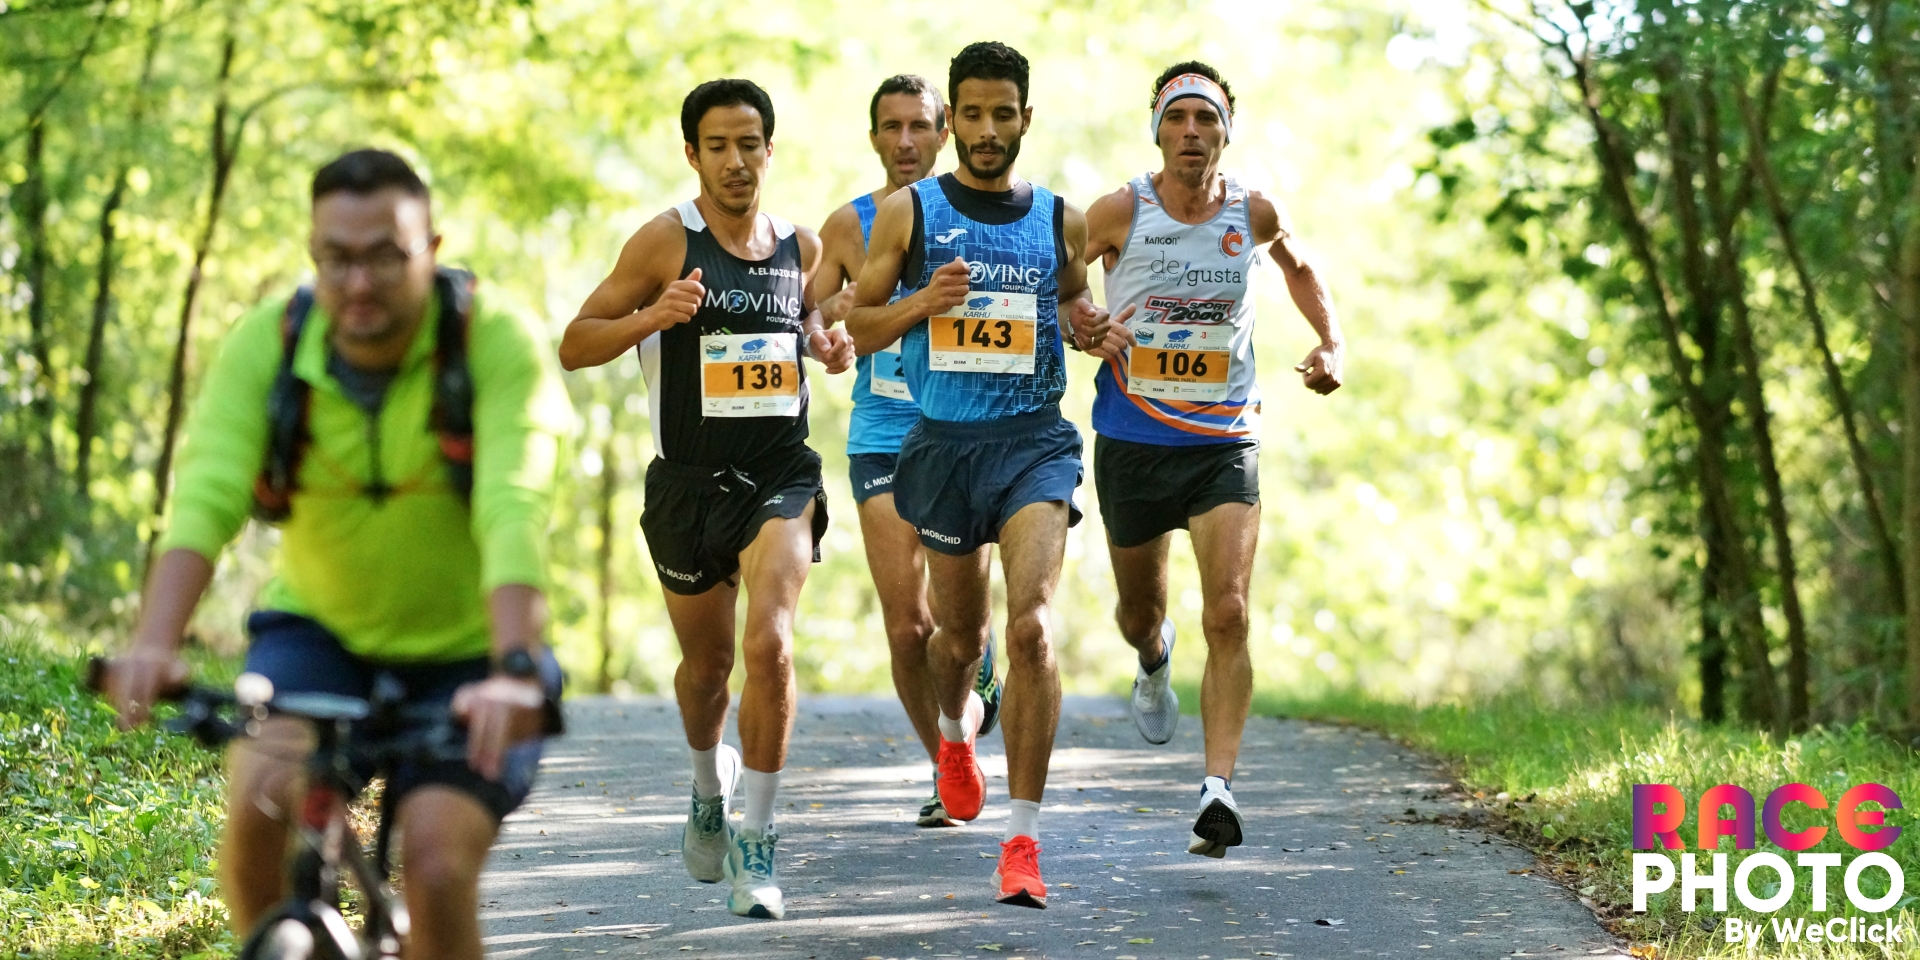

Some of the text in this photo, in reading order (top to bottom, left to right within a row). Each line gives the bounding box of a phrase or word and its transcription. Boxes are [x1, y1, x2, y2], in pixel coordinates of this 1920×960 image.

[748, 266, 758, 276] A.
[758, 267, 769, 276] EL
[968, 260, 1041, 286] OVING
[705, 288, 801, 318] MOVING
[1150, 300, 1230, 311] BICI SPORT
[1167, 306, 1224, 322] 2000
[953, 319, 1012, 348] 143
[738, 354, 766, 362] KARHU
[1156, 351, 1208, 377] 106
[732, 363, 783, 390] 138
[864, 481, 873, 490] G.
[921, 528, 961, 545] MORCHID
